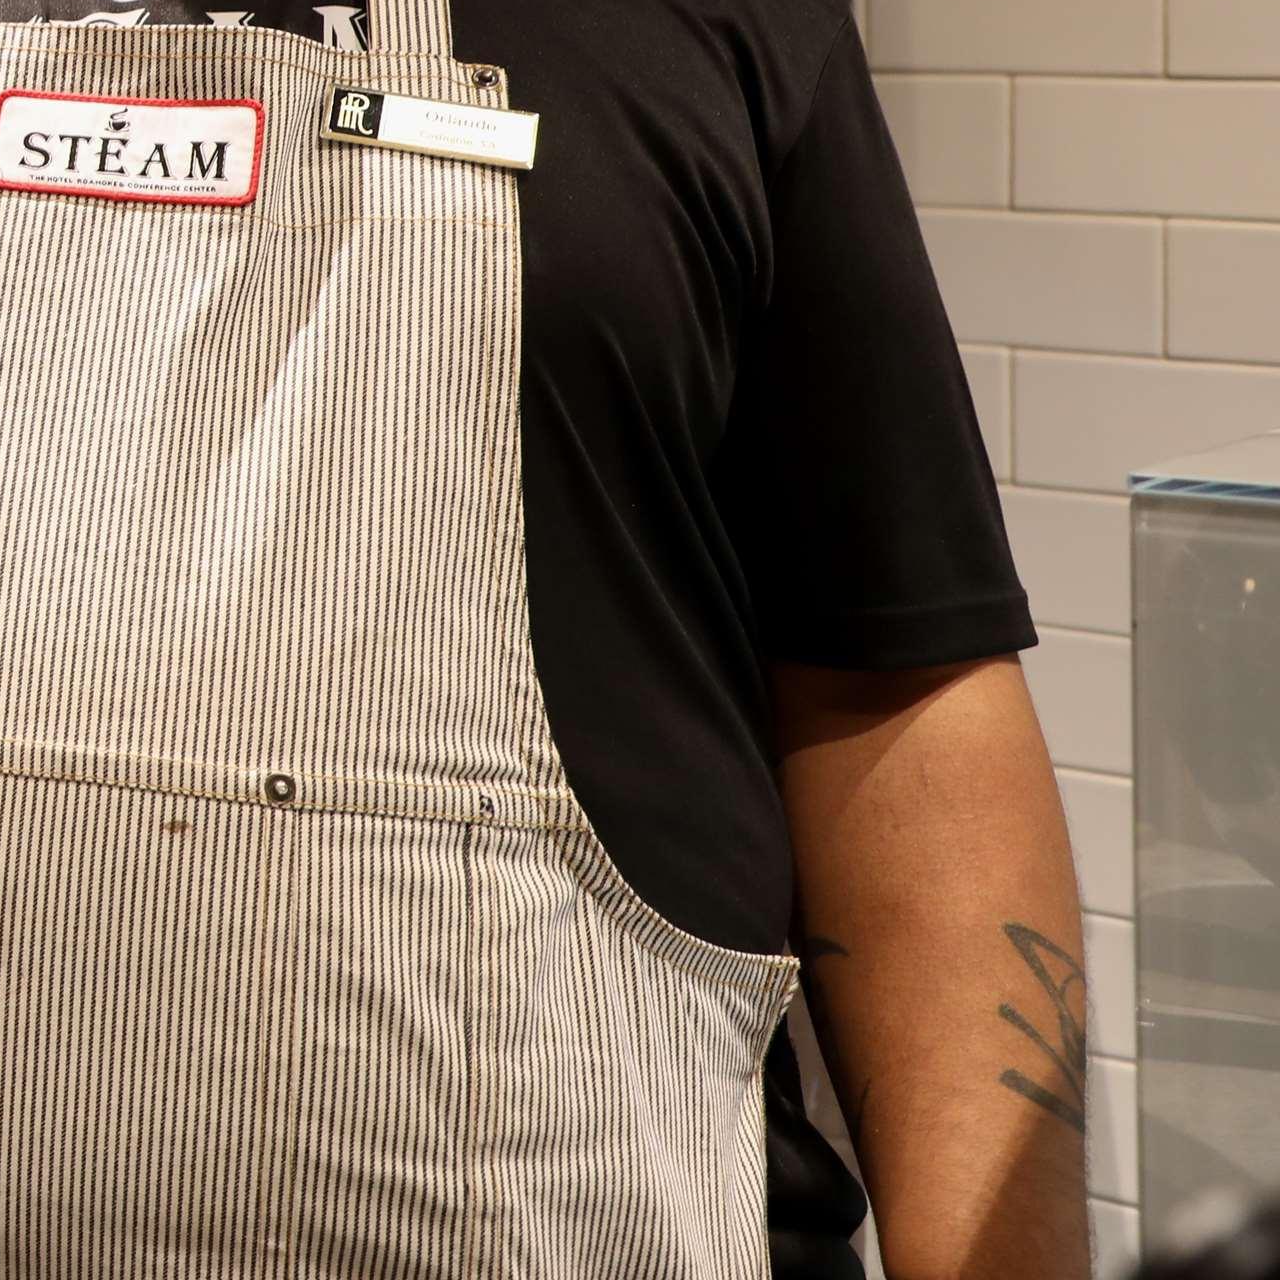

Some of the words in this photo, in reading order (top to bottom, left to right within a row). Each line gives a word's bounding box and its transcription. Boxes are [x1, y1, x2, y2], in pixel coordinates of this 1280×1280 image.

[425, 110, 497, 133] Orlando
[19, 131, 230, 182] STEAM
[30, 174, 45, 182] THE
[47, 175, 73, 184] HOTEL
[77, 178, 118, 188] ROANOKE
[128, 182, 181, 193] CONFERENCE
[183, 185, 217, 193] CENTER
